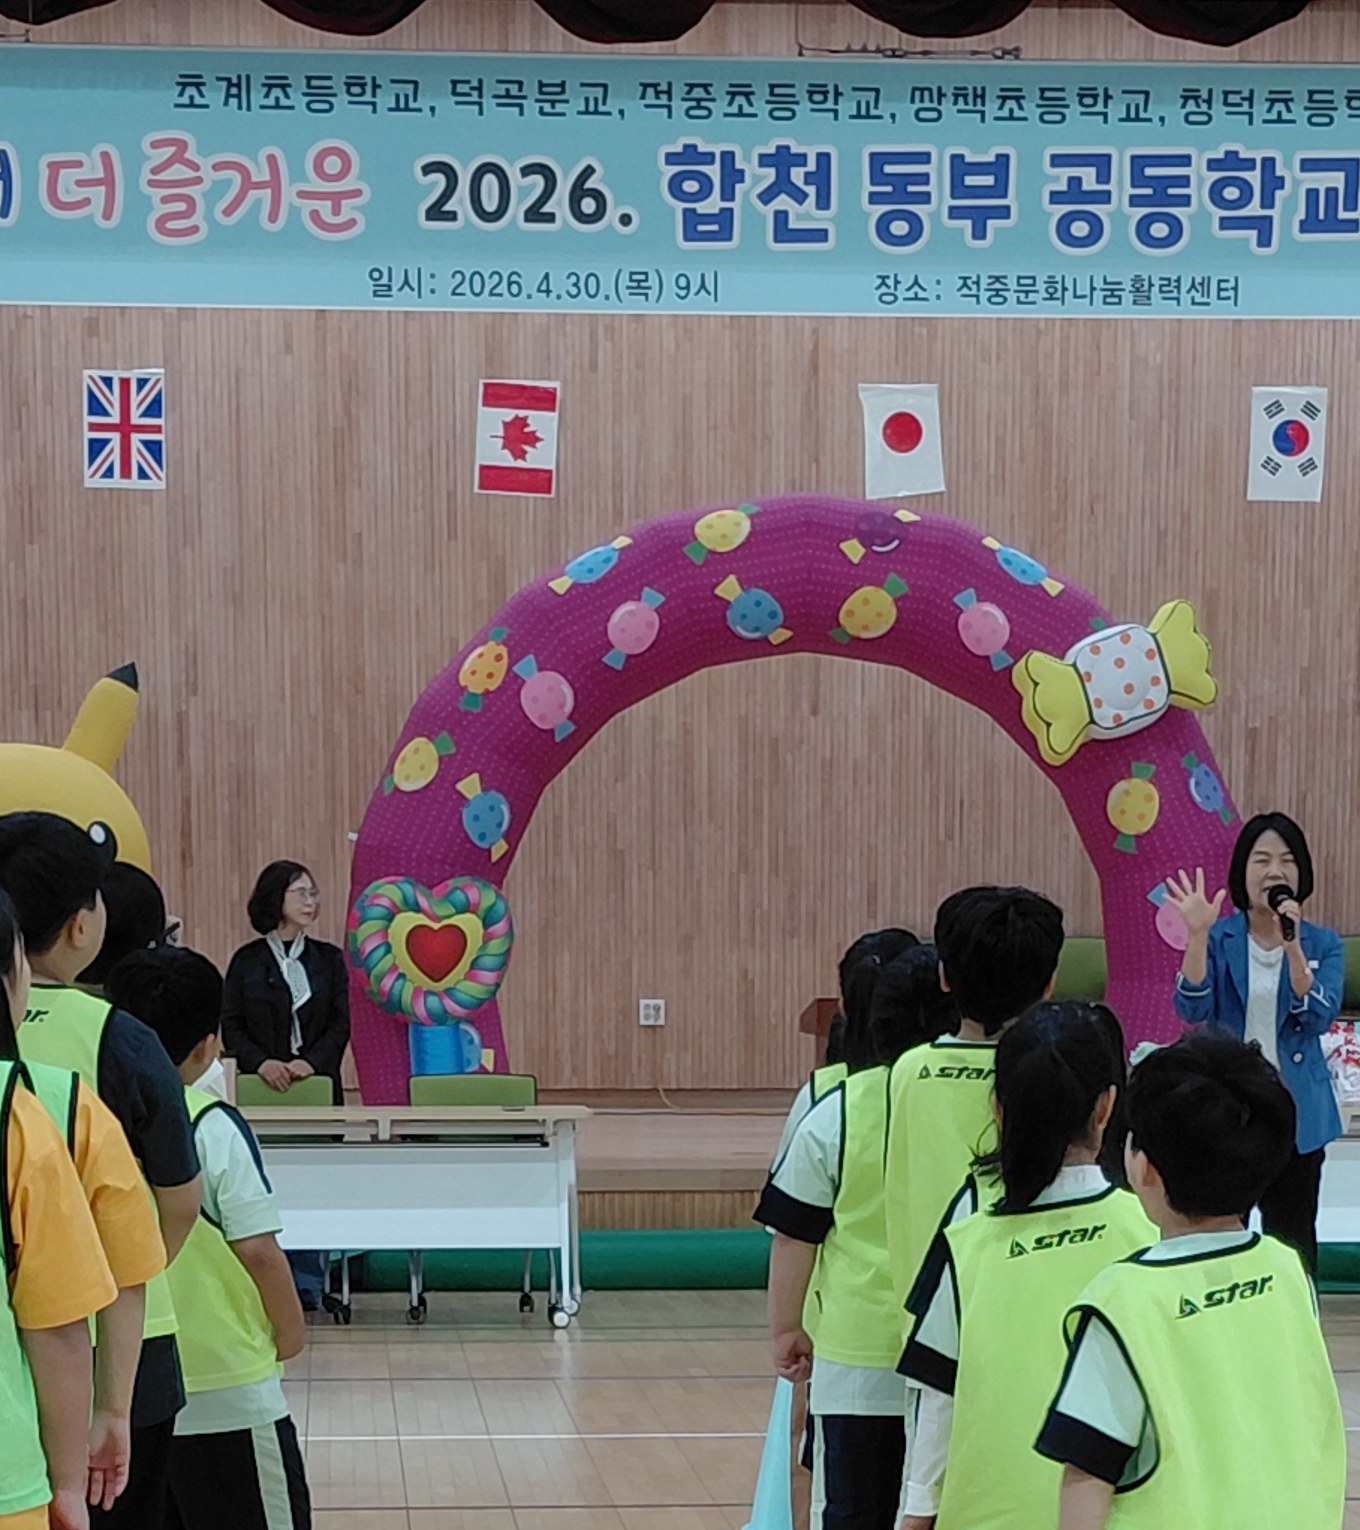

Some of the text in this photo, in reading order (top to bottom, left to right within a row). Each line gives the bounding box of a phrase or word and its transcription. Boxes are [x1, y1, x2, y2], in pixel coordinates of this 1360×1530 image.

[173, 73, 437, 118] 초계초등학교,
[449, 76, 626, 120] 덕곡분교,
[638, 80, 897, 124] 적중초등학교,
[45, 149, 116, 222] 더
[145, 136, 364, 239] 즐거운
[418, 159, 634, 228] 2026.
[662, 142, 834, 245] 합천
[867, 150, 1013, 248] 동부
[367, 265, 720, 303] 일시: 2026.4.30.(목) 9시
[873, 272, 1242, 308] 장소: 적중문화나눔활력센터
